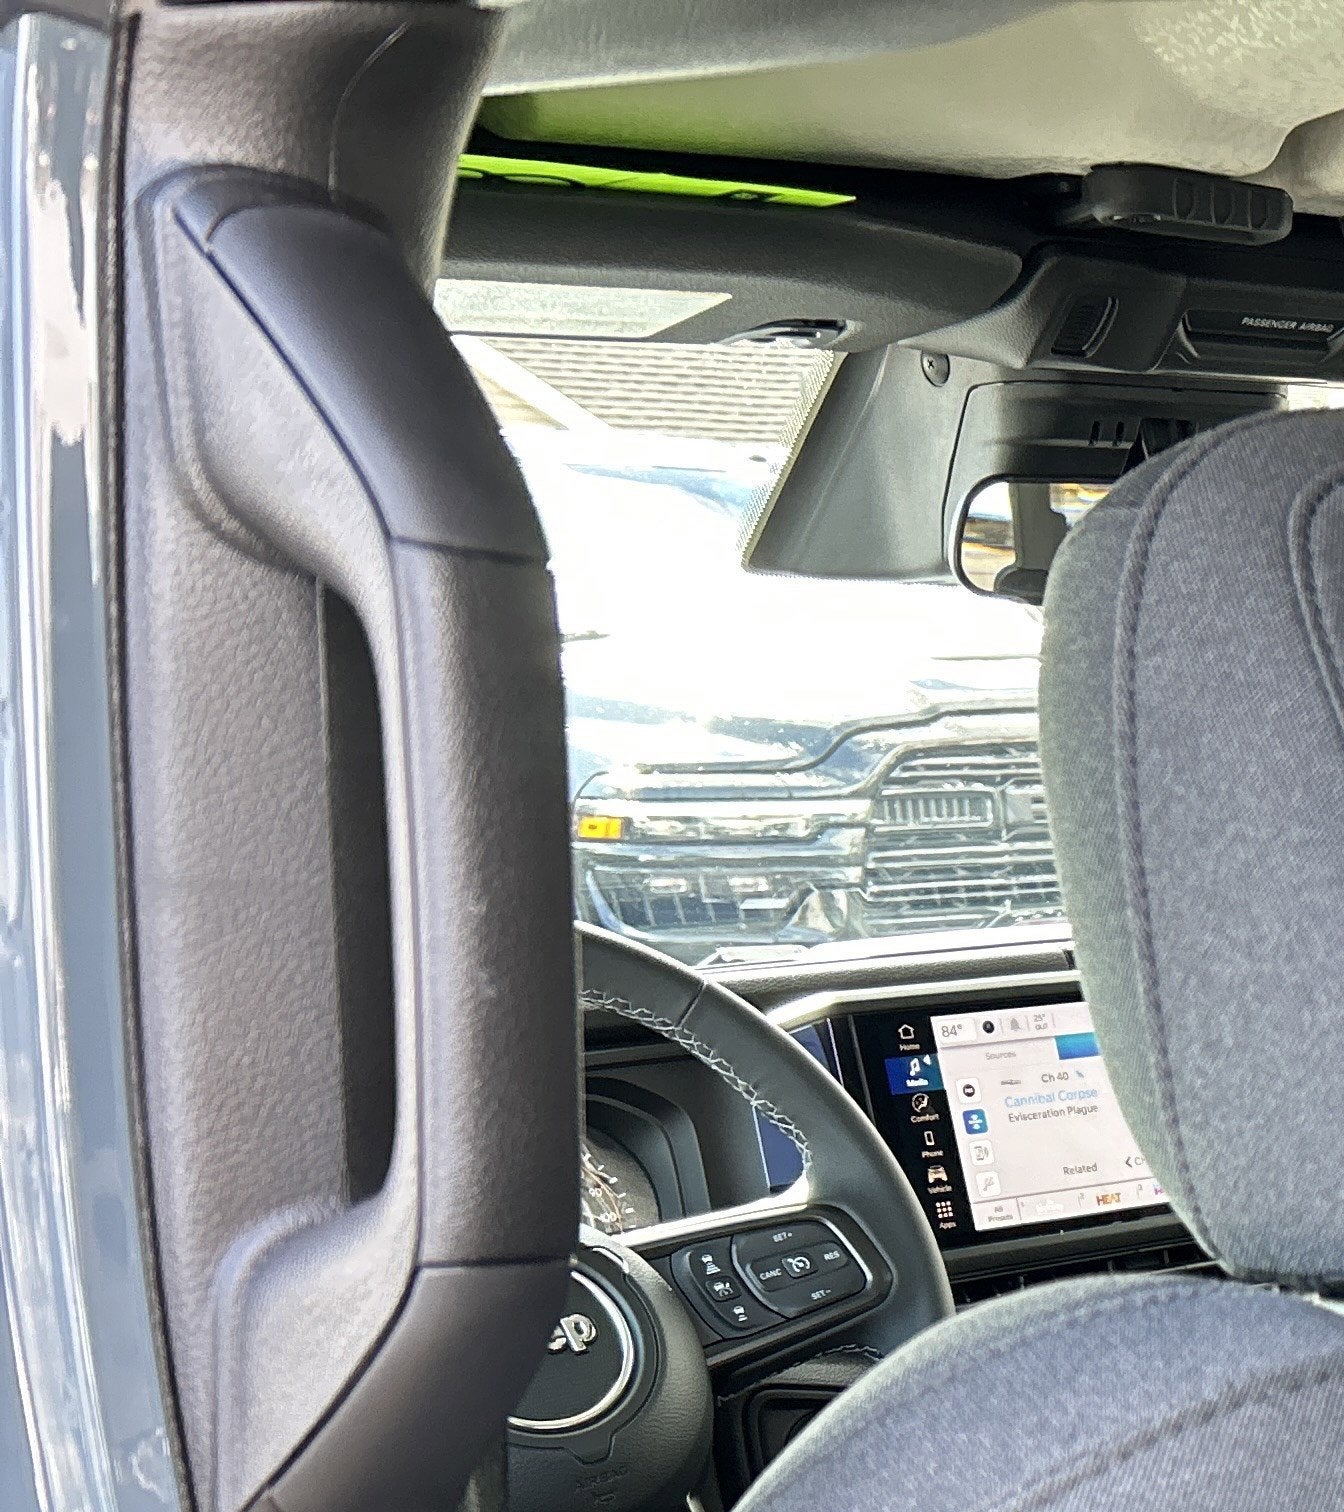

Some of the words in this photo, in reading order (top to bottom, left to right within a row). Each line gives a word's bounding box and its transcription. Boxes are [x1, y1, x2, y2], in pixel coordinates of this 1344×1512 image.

[1241, 317, 1297, 330] PASSENGER
[1299, 322, 1334, 333] AIRBAG
[941, 1023, 963, 1037] 84°
[985, 1051, 1017, 1061] Sources
[1041, 1073, 1055, 1083] Ch
[1057, 1072, 1069, 1081] 40
[1004, 1091, 1056, 1108] Cannibal
[1058, 1088, 1099, 1102] Corpse
[1008, 1107, 1066, 1123] Evisceration
[1067, 1104, 1099, 1116] Plague
[1062, 1162, 1098, 1175] Related
[1096, 1192, 1122, 1206] HEAT
[823, 1251, 840, 1261] RES
[760, 1268, 782, 1280] CANC
